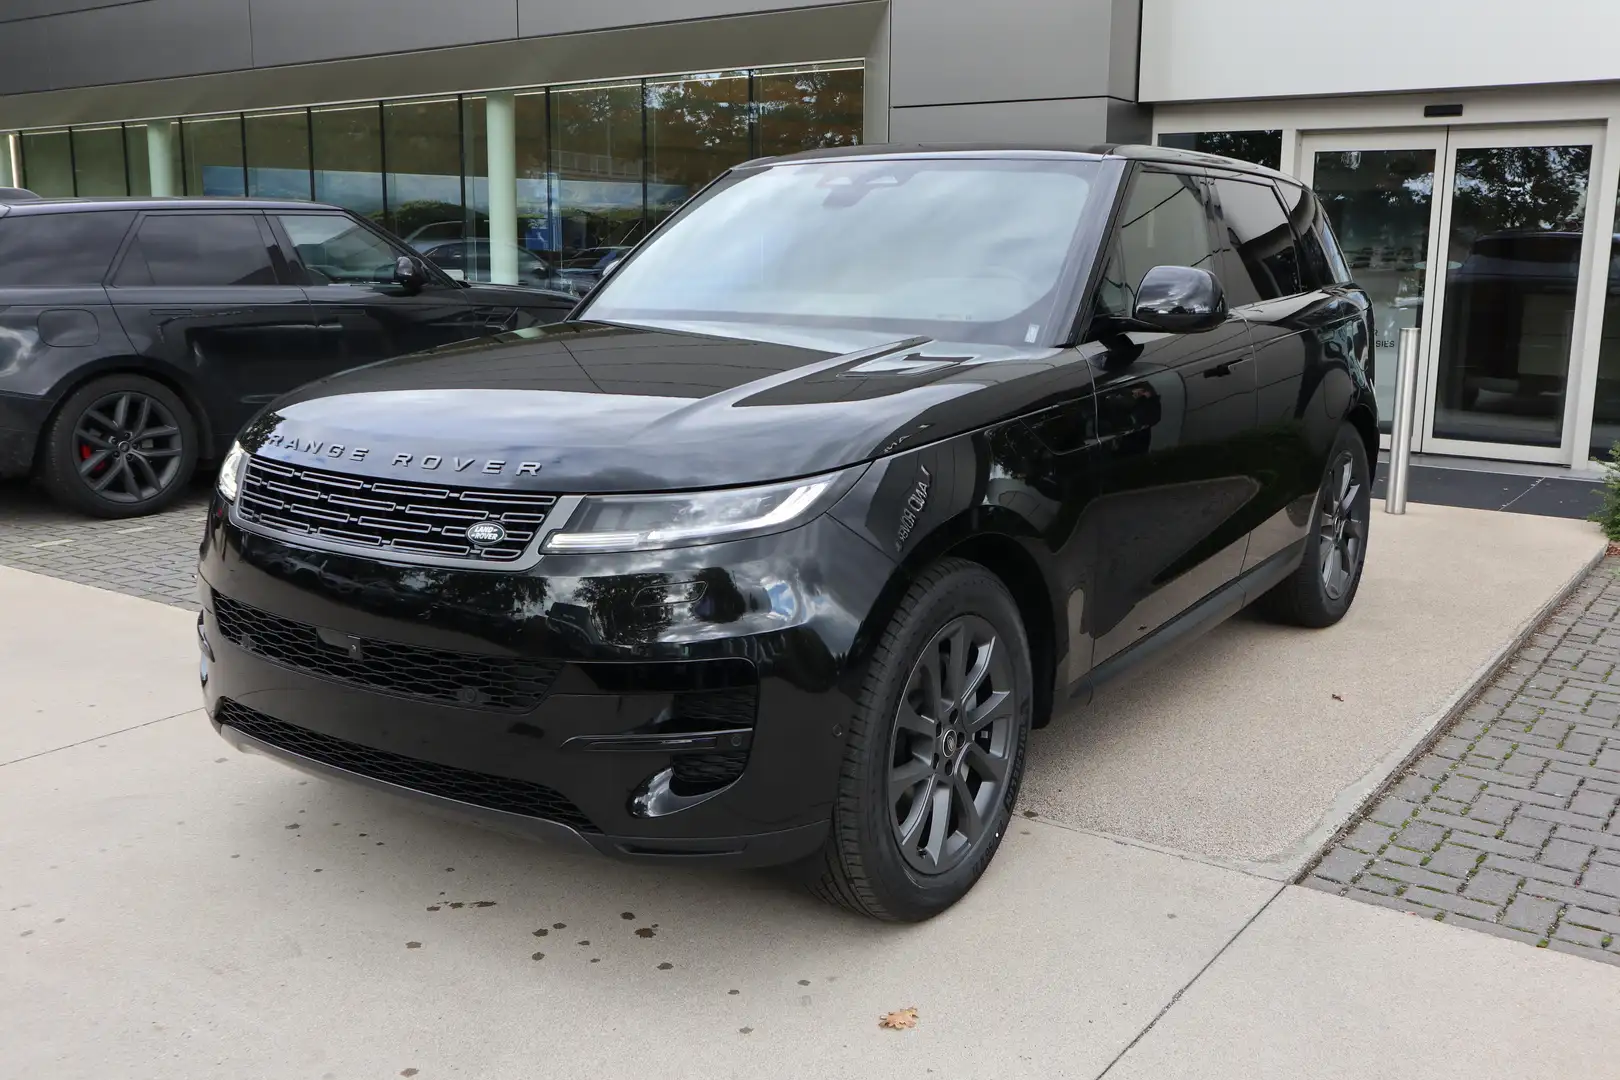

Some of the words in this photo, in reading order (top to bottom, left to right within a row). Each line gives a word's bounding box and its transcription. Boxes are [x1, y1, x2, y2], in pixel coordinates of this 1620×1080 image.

[269, 434, 370, 462] RANGE
[391, 452, 542, 477] ROVER
[474, 532, 498, 540] ROVER
[1004, 725, 1027, 811] MICHELIN
